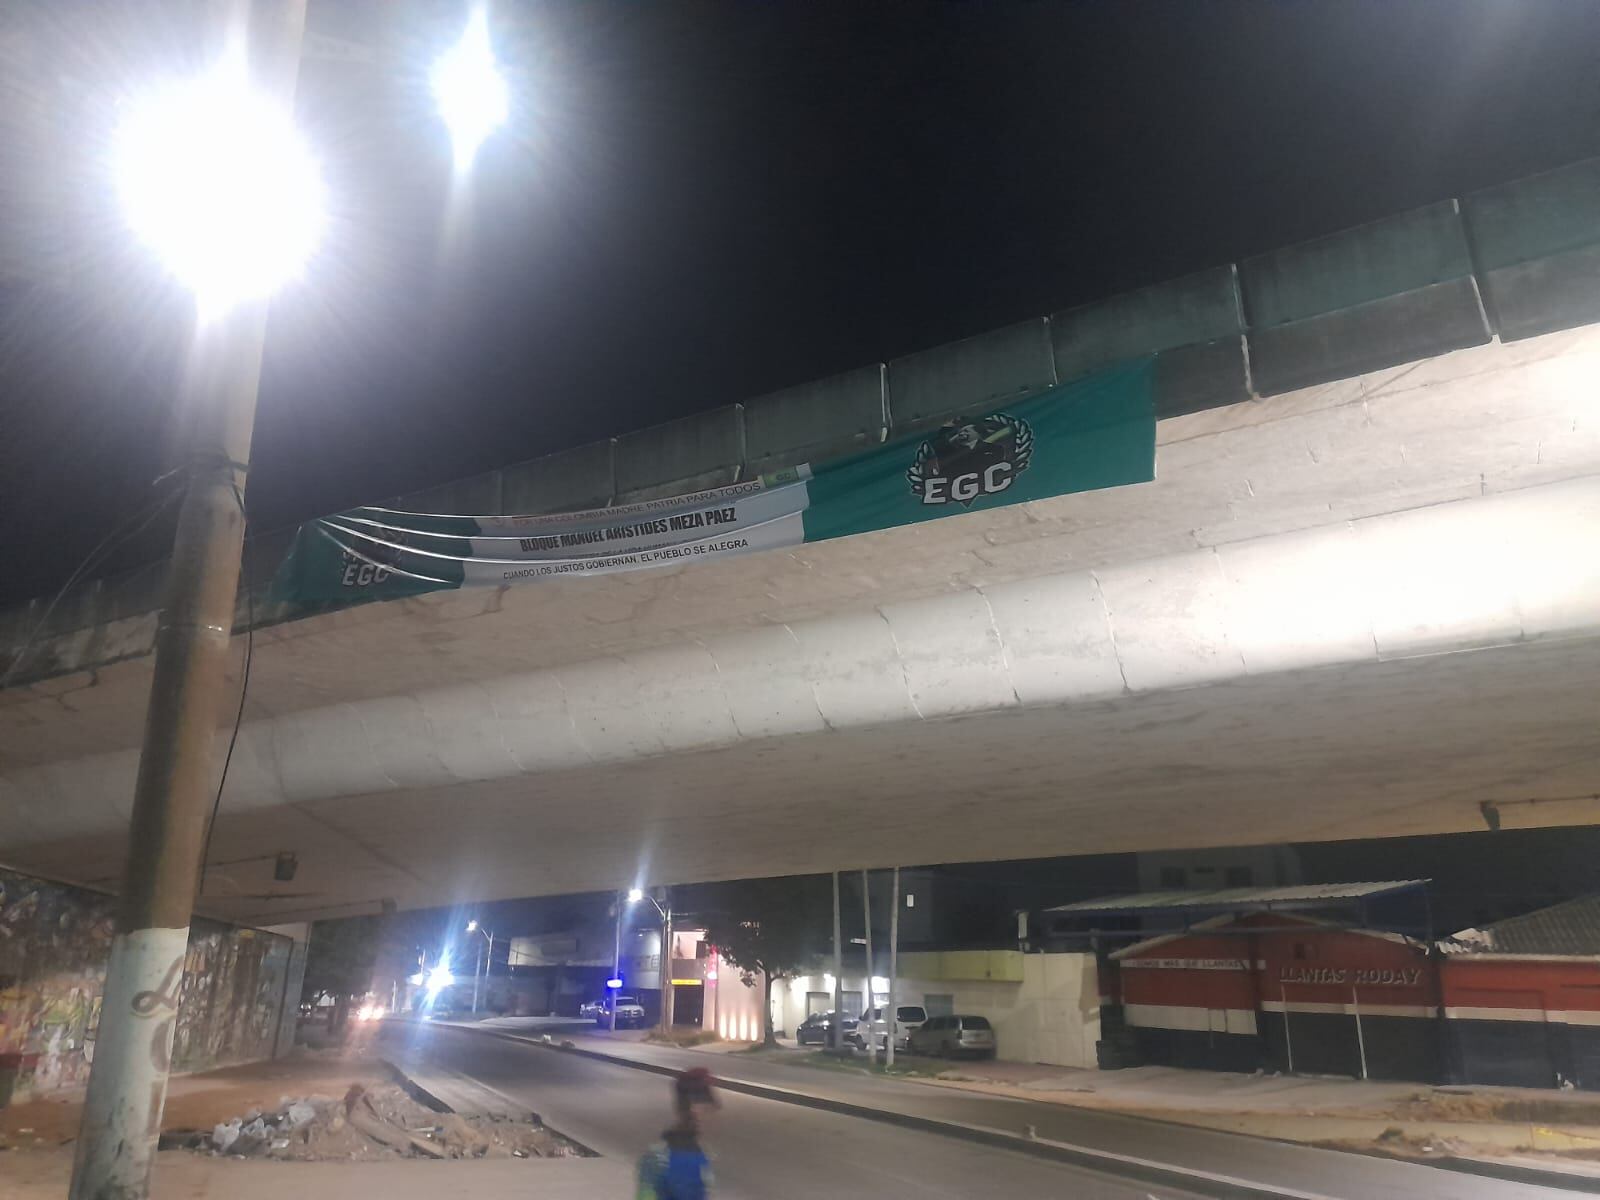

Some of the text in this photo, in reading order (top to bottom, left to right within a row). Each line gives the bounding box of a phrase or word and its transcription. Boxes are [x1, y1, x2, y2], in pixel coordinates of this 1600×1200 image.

[646, 498, 684, 511] PATRIA
[686, 491, 717, 504] PARA
[719, 482, 762, 497] TODOS
[922, 461, 1012, 504] EGC
[520, 536, 560, 552] BLOQUE
[670, 512, 704, 531] MEZA
[706, 507, 737, 526] PAEZ
[503, 568, 535, 580] CUANDO
[537, 566, 552, 576] LOS
[553, 563, 585, 573] JUSTOS
[640, 554, 653, 562] EL
[653, 547, 692, 561] PUEBLO
[693, 545, 706, 555] SE
[708, 539, 749, 553] ALEGRA
[1280, 967, 1347, 985] LLANTAS
